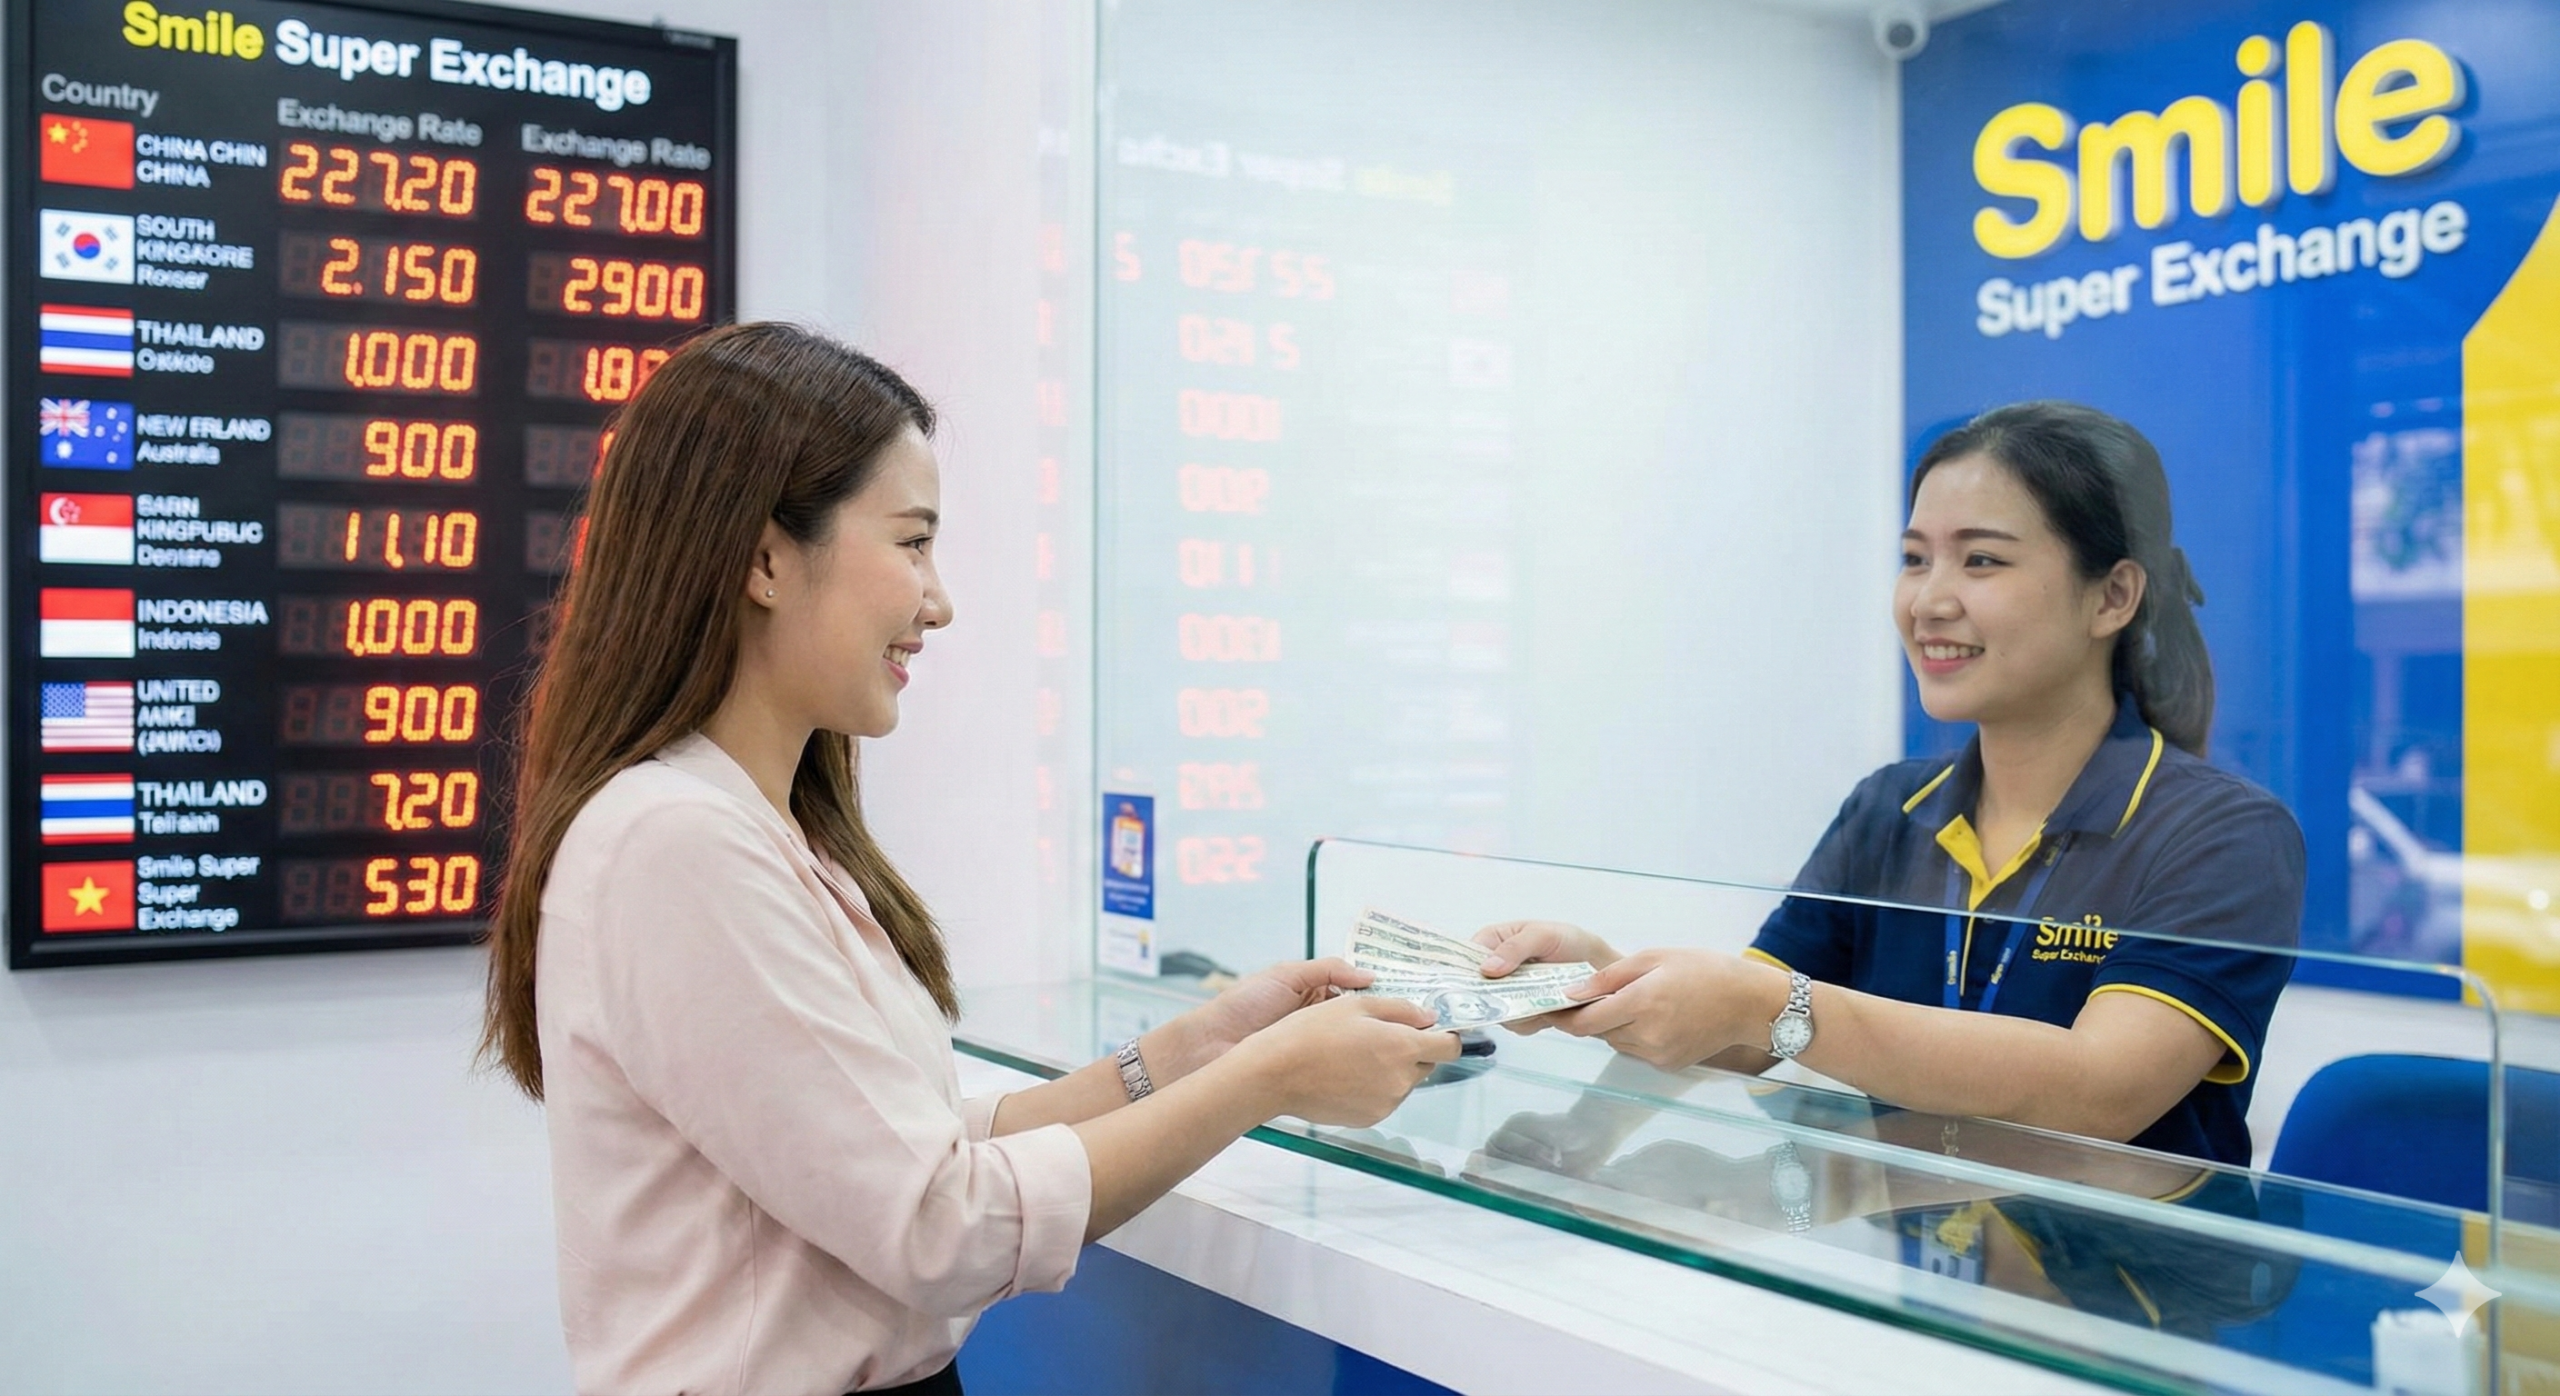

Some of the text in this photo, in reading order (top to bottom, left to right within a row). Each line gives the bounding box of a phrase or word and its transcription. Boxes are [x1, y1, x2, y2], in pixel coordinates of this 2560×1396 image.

[123, 1, 651, 111] Smile Super Exchange
[41, 73, 159, 114] Country
[278, 98, 482, 146] Exchange Rate
[136, 134, 267, 167] CHINA CHIN
[521, 125, 711, 170] Exchange Rate
[1972, 20, 2468, 260] Smile
[136, 160, 211, 188] CHINA
[136, 214, 215, 240] SOUTH
[1976, 200, 2469, 340] Super Exchange
[563, 258, 704, 320] 2900
[136, 320, 265, 350] THAILAND
[137, 414, 187, 437] NEW
[364, 420, 477, 480] 900
[138, 599, 268, 624] INDONESIA
[138, 680, 220, 702] UNITED
[364, 685, 478, 742] 900
[137, 780, 267, 806] THAILAND
[138, 854, 260, 879] Smile Super
[138, 882, 200, 907] Super
[365, 855, 479, 915] 530
[138, 906, 238, 932] Exchange
[2036, 914, 2118, 949] Smile
